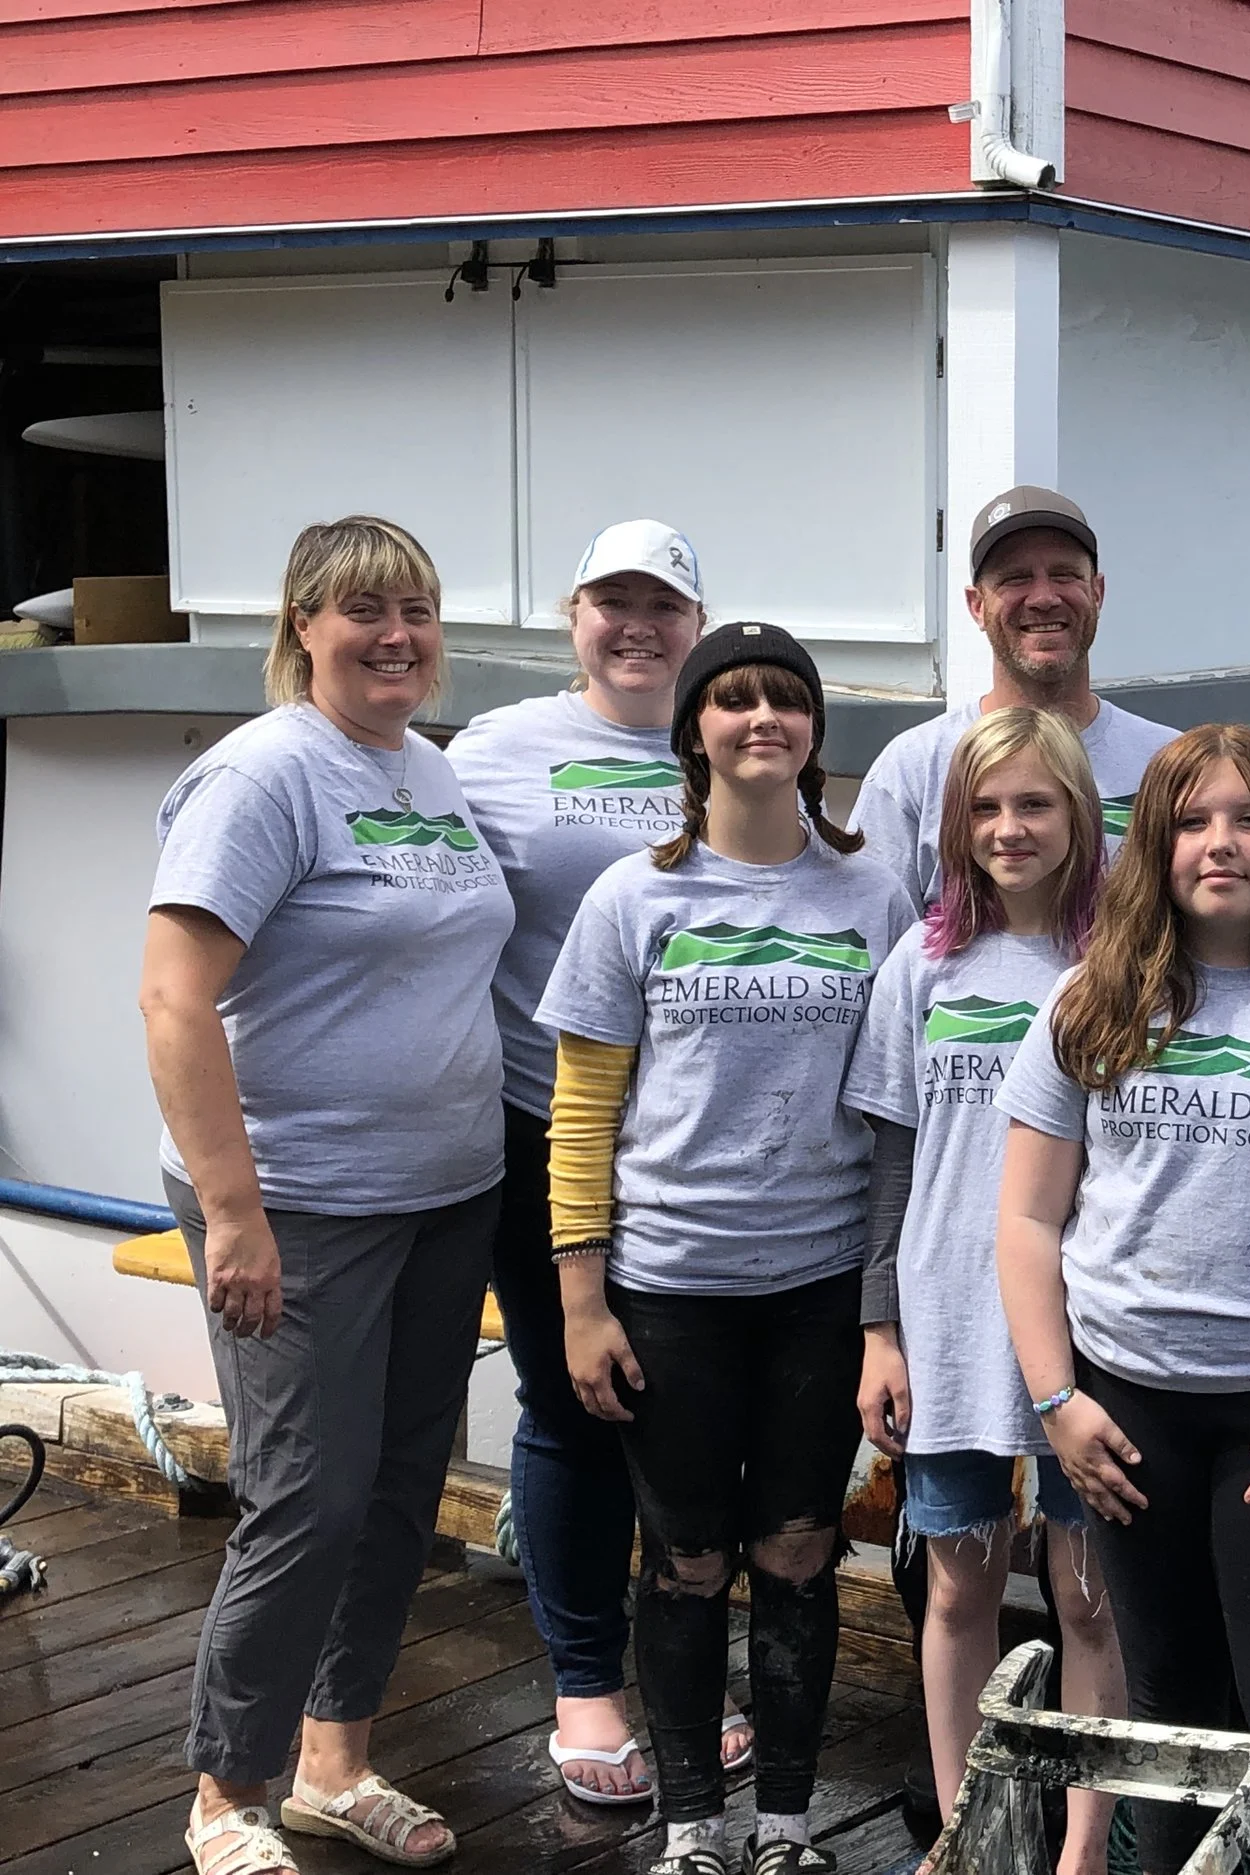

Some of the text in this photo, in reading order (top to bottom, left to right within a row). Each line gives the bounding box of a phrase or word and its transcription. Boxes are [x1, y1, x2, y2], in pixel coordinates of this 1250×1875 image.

[553, 796, 683, 817] EMERAL
[554, 814, 686, 832] PROTECTION
[361, 852, 490, 876] EMERALD SEA
[371, 873, 456, 894] PROTECTION
[661, 974, 866, 1004] EMERALD SEA
[663, 1004, 786, 1025] PROTECTION
[1101, 1117, 1228, 1145] PROTECTION
